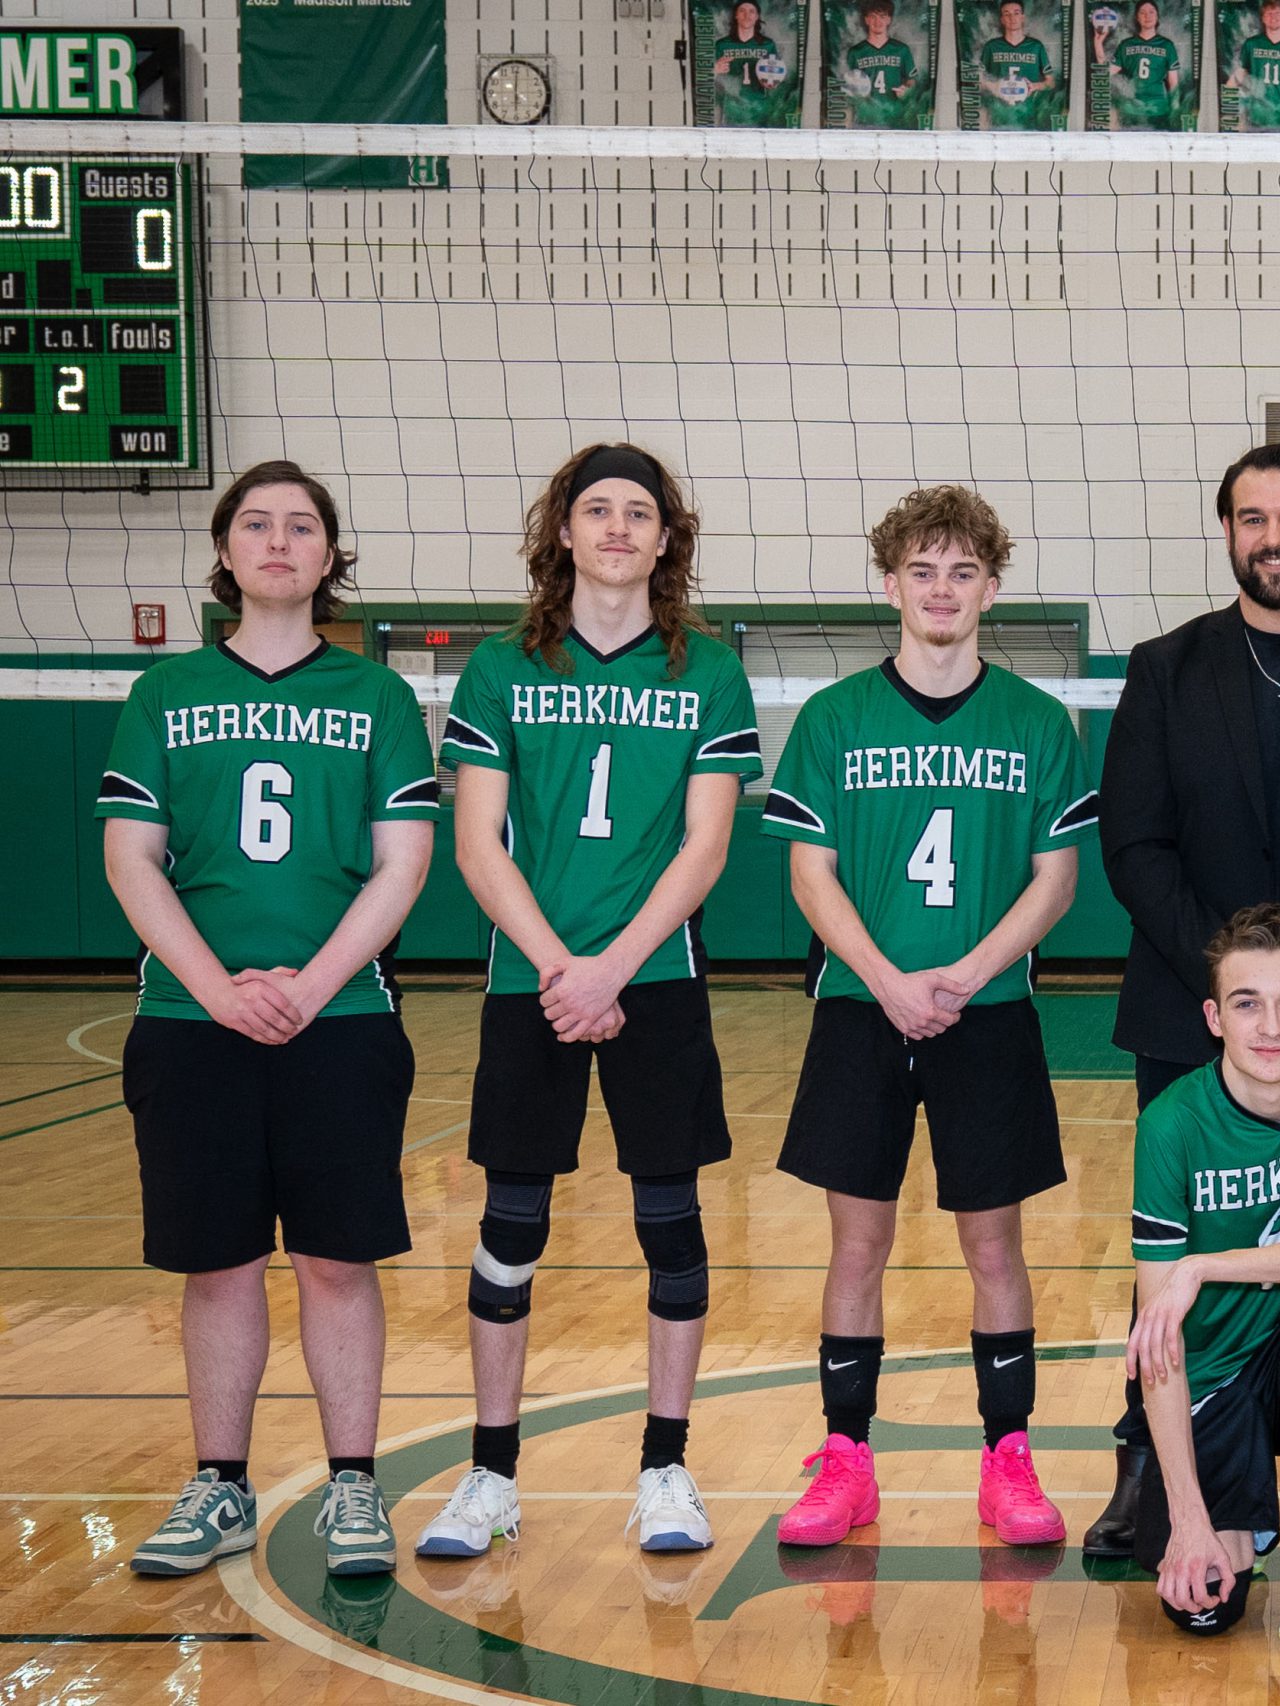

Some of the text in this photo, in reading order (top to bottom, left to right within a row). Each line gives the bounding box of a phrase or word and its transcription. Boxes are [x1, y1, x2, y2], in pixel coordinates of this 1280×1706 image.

[0, 37, 135, 110] MER
[742, 62, 751, 85] 1
[874, 70, 886, 94] 4
[1138, 57, 1151, 80] 6
[1263, 62, 1280, 85] 11
[961, 61, 982, 131] ROWLEY
[1091, 61, 1111, 132] FARRELL
[1221, 84, 1240, 132] FLINT
[84, 169, 169, 198] Guests
[408, 156, 439, 186] H
[136, 208, 172, 270] 0
[44, 324, 94, 348] t.o.l.
[111, 323, 171, 350] fouls
[57, 366, 84, 411] 2
[121, 431, 167, 452] won
[164, 702, 372, 752] HERKIMER
[511, 683, 700, 730] HERKIMER
[577, 743, 613, 840] 1
[843, 744, 1027, 794] HERKIMER
[238, 760, 294, 864] 6
[907, 807, 956, 908] 4
